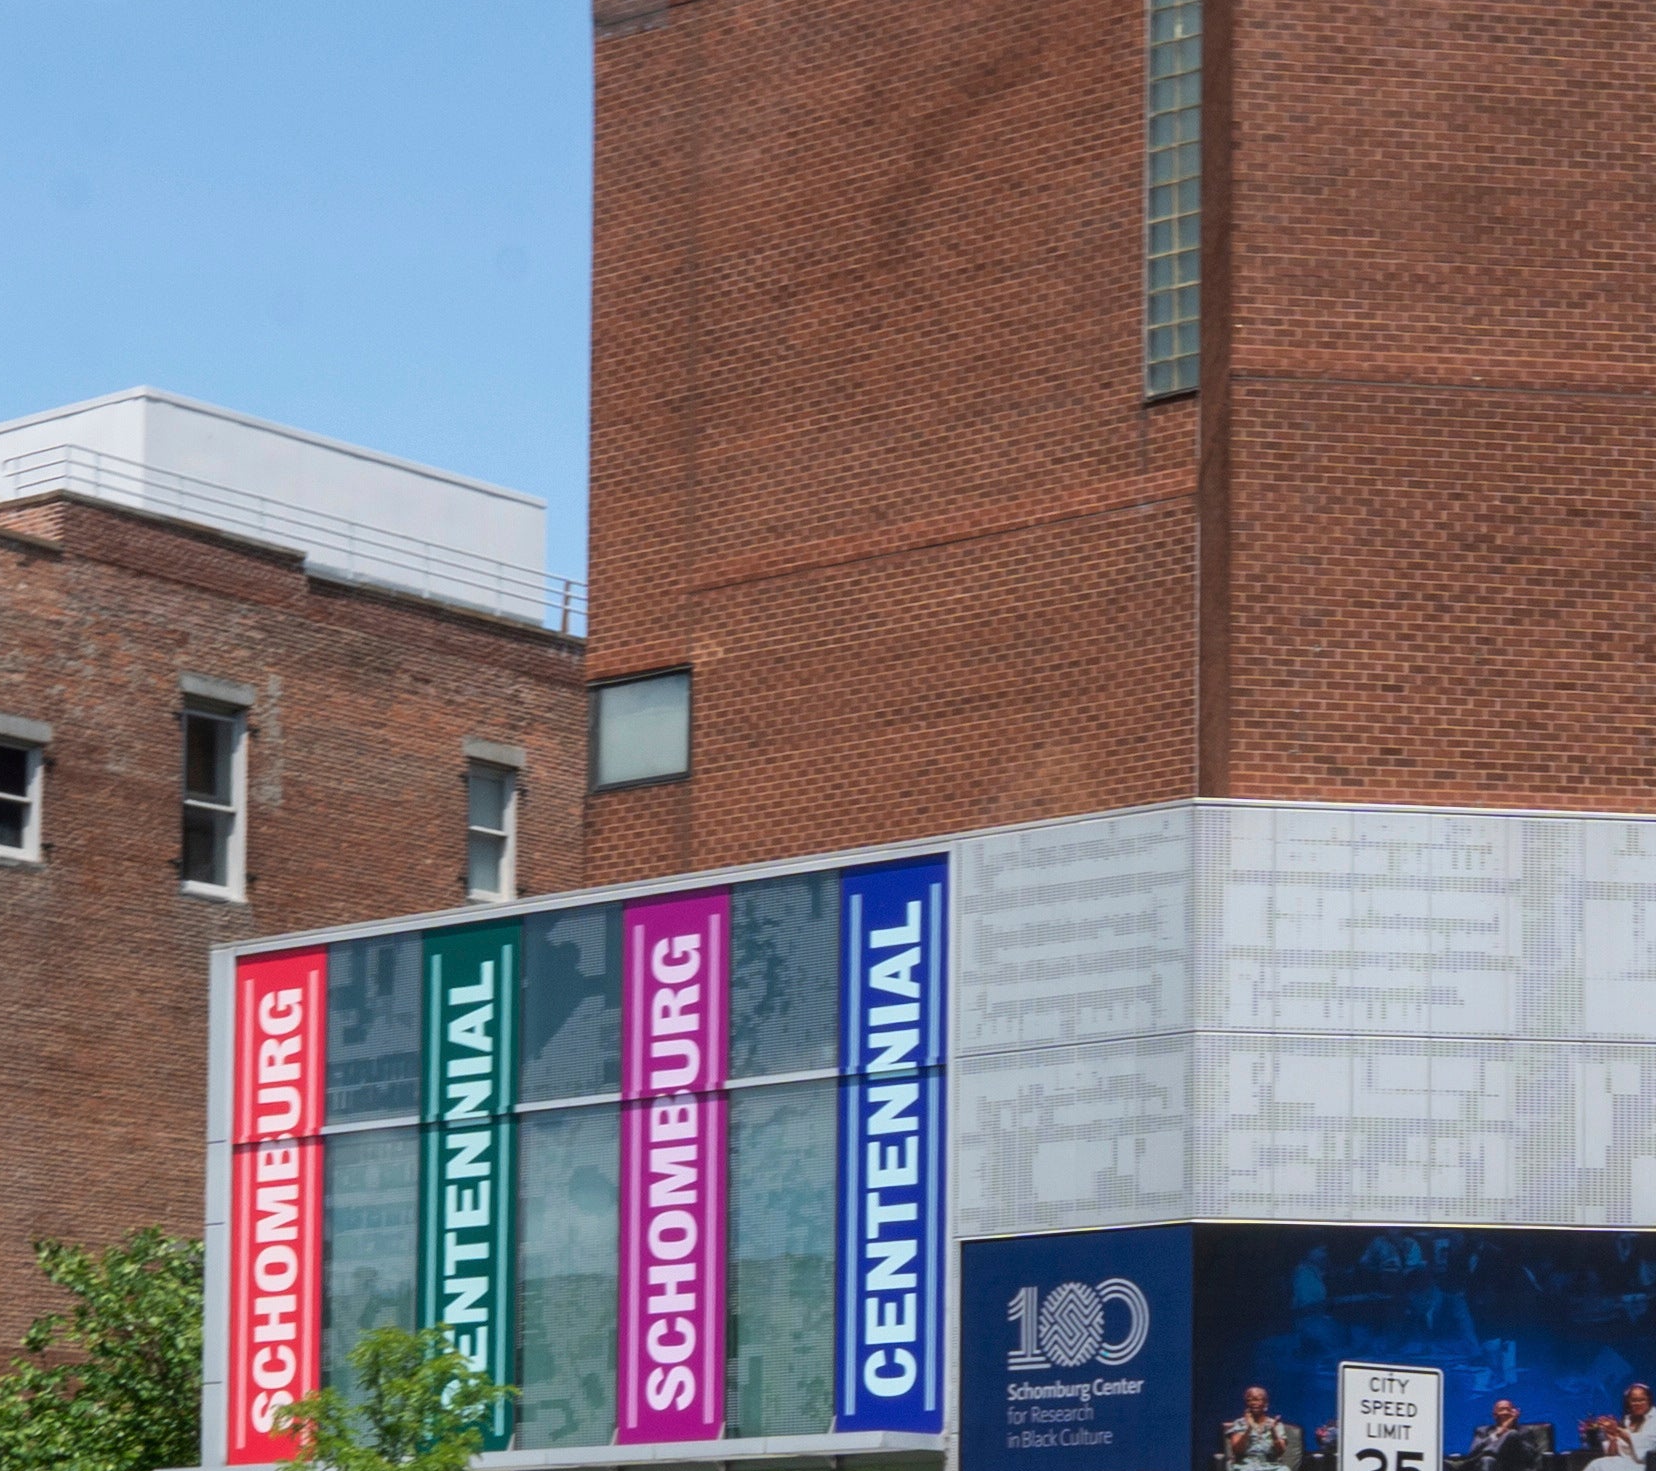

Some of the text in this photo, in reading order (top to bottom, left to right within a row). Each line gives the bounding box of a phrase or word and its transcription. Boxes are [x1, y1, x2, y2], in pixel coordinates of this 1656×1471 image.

[863, 900, 923, 1398] CENTENNIAL
[646, 933, 701, 1412] SCHOMBURG
[251, 987, 303, 1434] SCHOMBURG
[1007, 1379, 1144, 1402] Schomburg Center
[1369, 1376, 1409, 1394] CITY
[1007, 1404, 1094, 1424] for Research
[1360, 1399, 1418, 1418] SPEED
[1007, 1428, 1113, 1448] in Black Culture
[1367, 1423, 1412, 1440] LIMIT
